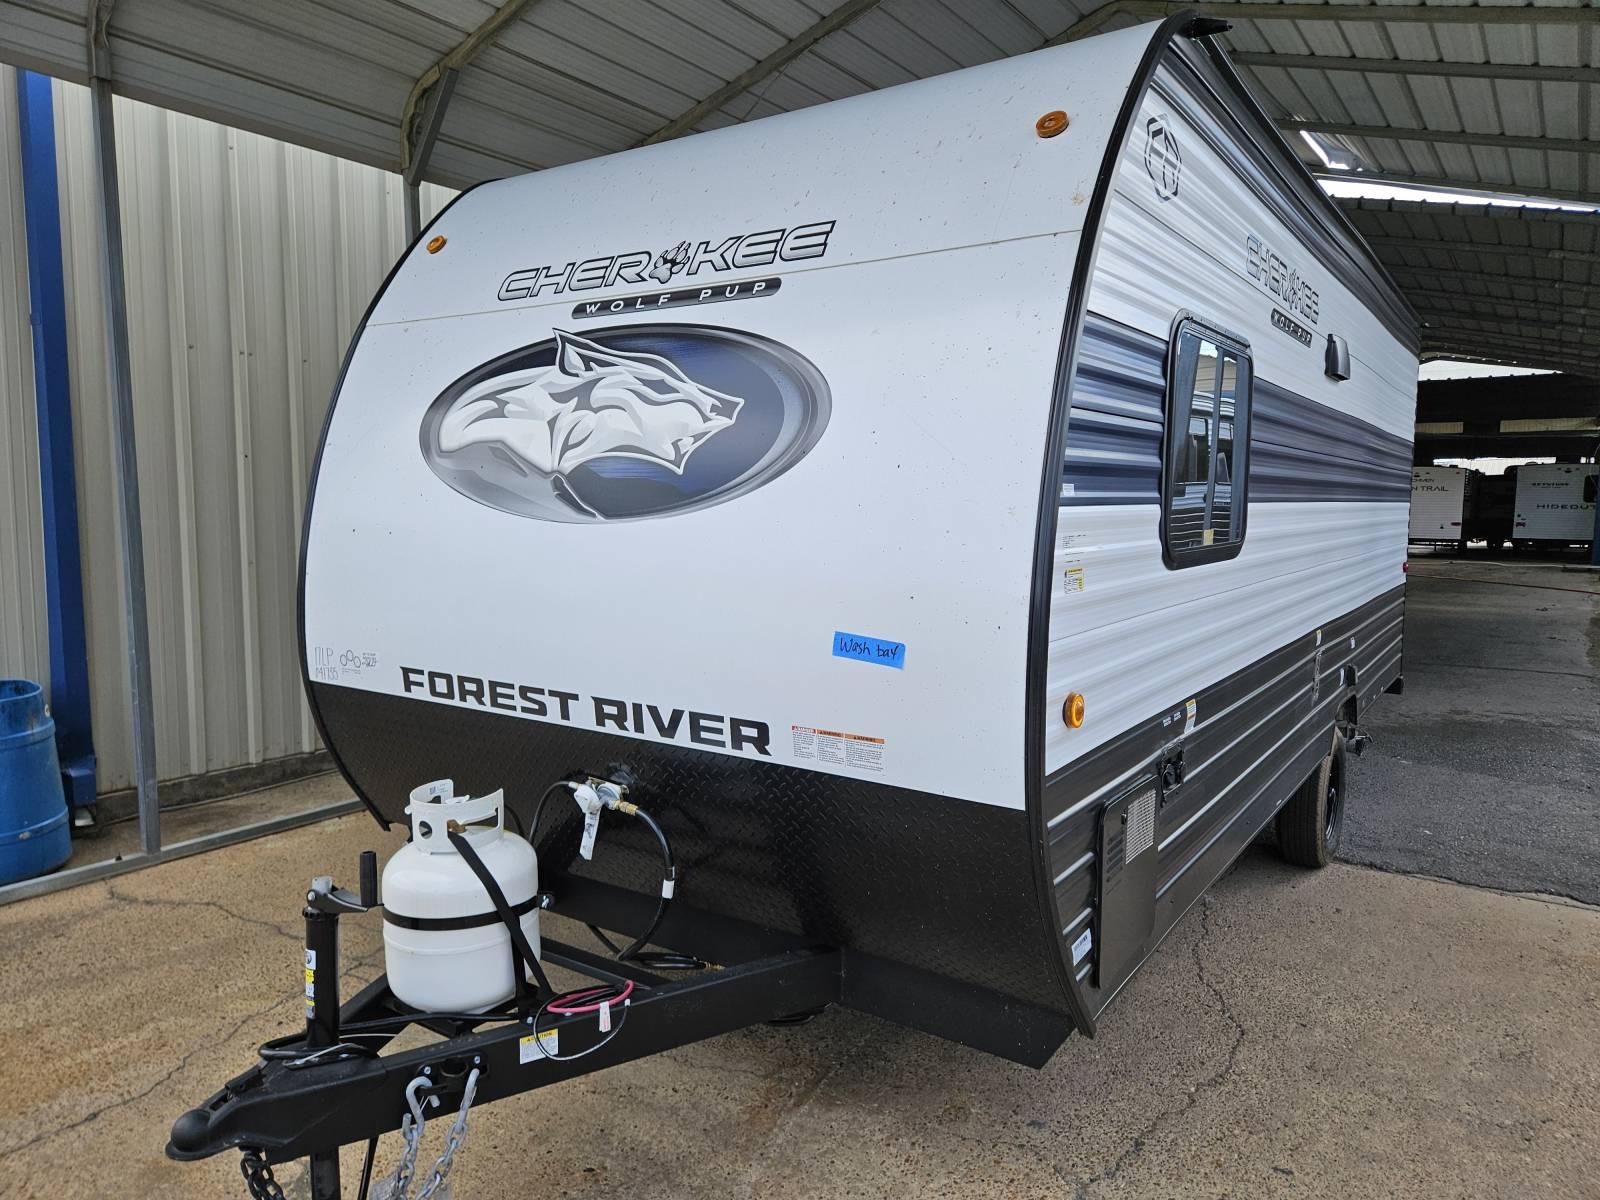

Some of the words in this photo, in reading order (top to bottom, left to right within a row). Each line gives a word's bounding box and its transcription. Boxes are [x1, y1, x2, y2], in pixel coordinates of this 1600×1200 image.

[585, 294, 671, 314] WOLF
[699, 281, 766, 301] PUP
[1274, 312, 1294, 332] WOLF
[840, 637, 871, 656] Wash
[877, 643, 899, 660] bay
[400, 666, 580, 721] FOREST
[590, 696, 772, 757] RIVER
